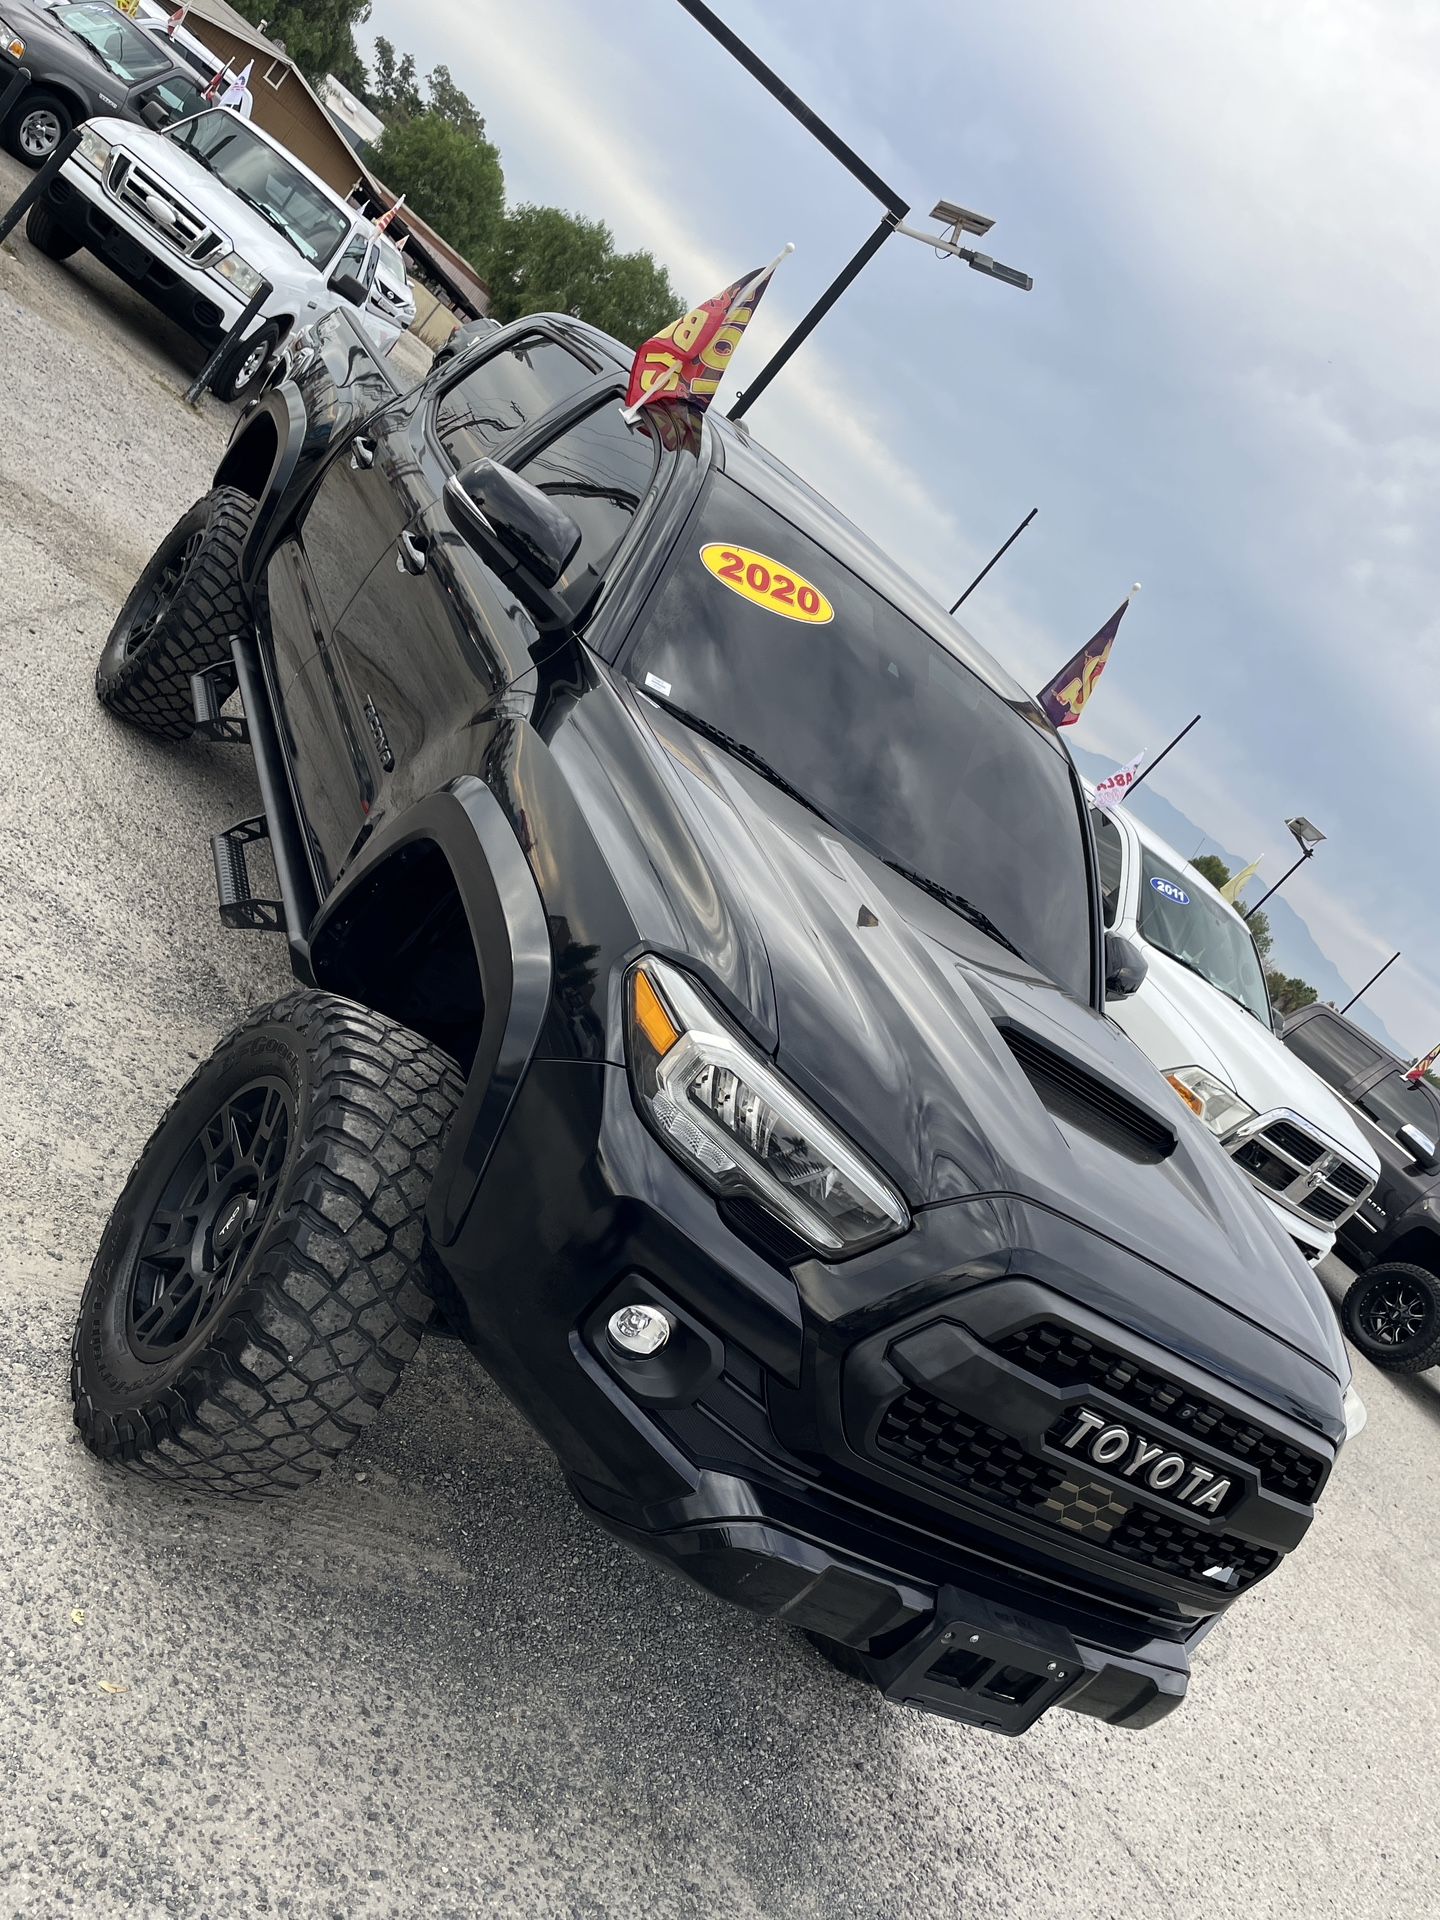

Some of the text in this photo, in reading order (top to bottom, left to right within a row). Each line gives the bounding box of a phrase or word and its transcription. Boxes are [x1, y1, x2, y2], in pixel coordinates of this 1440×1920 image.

[717, 551, 821, 616] 2020
[1157, 880, 1185, 902] 2011
[218, 1206, 240, 1236] TRD
[1064, 1411, 1231, 1513] TOYOTA
